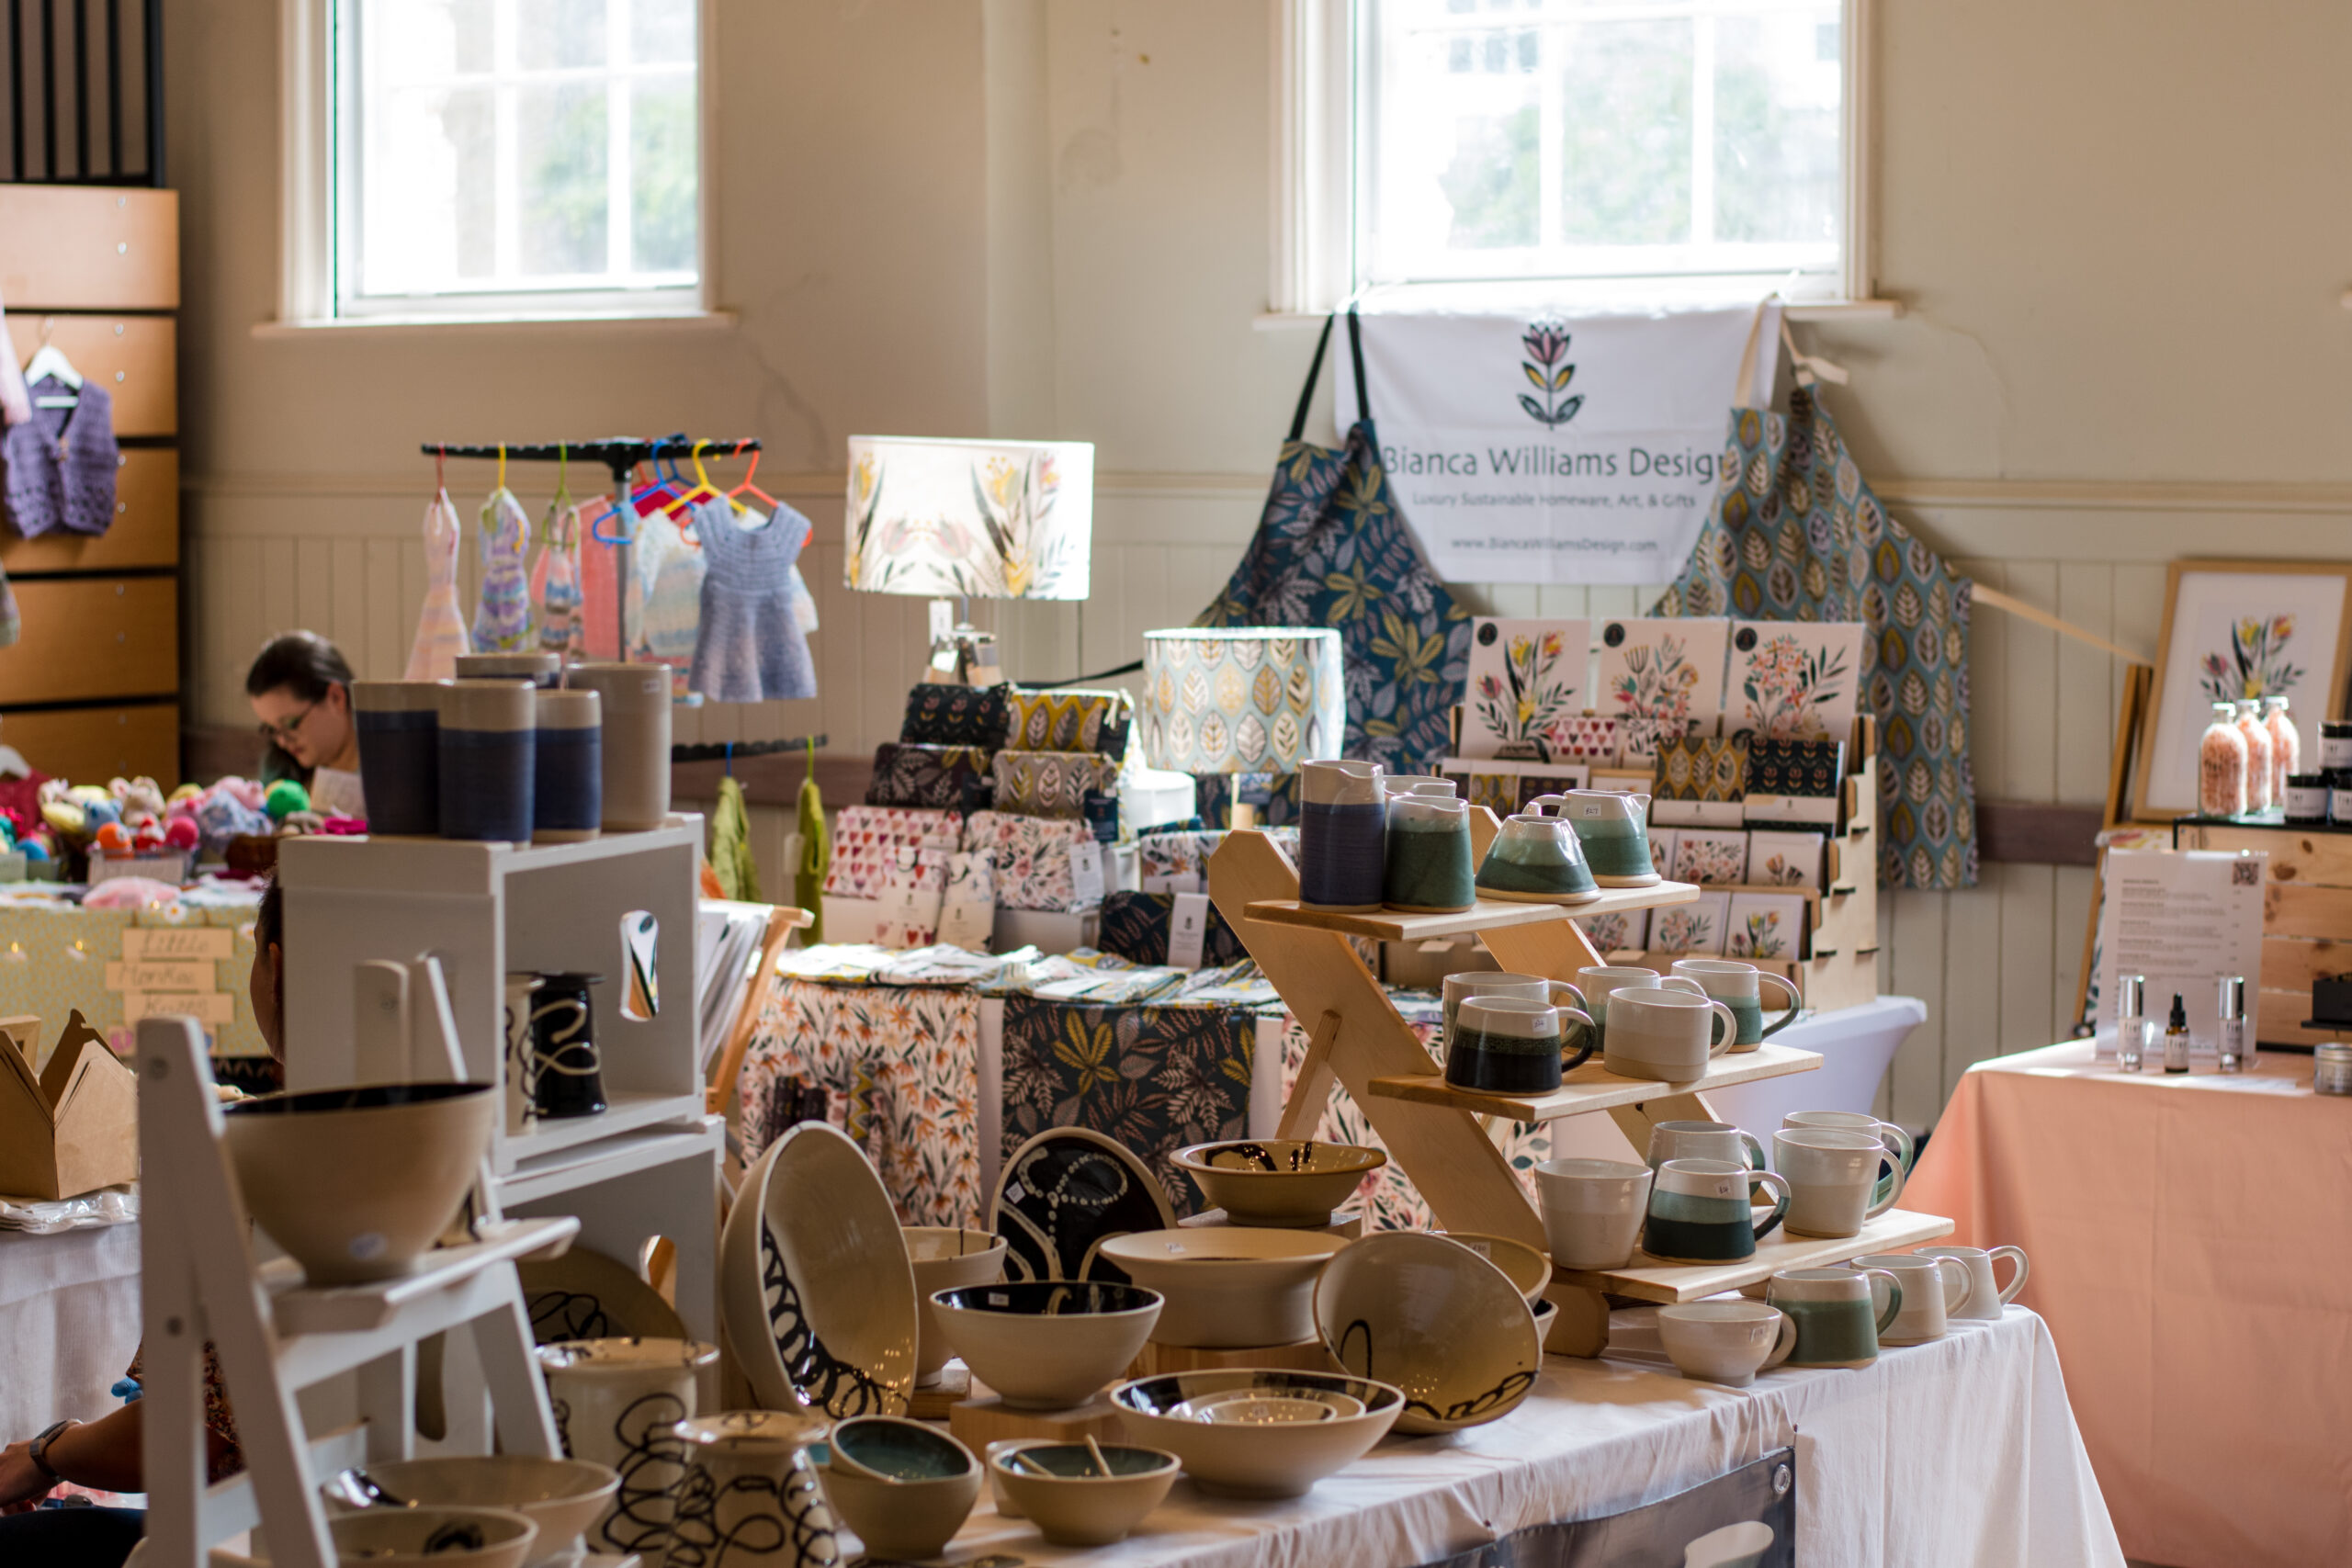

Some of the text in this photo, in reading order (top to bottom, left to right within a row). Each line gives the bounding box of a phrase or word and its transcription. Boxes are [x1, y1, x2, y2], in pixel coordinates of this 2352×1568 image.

[1383, 446, 1477, 476] Bianca
[1488, 446, 1617, 477] Williams
[1413, 491, 1456, 507] Luxury
[1461, 491, 1535, 506] Sustainable
[1647, 493, 1657, 507] &
[1662, 493, 1696, 508] Gifts
[1452, 536, 1657, 555] www.BiancaWilliamsDesign.com
[140, 927, 209, 953] Little
